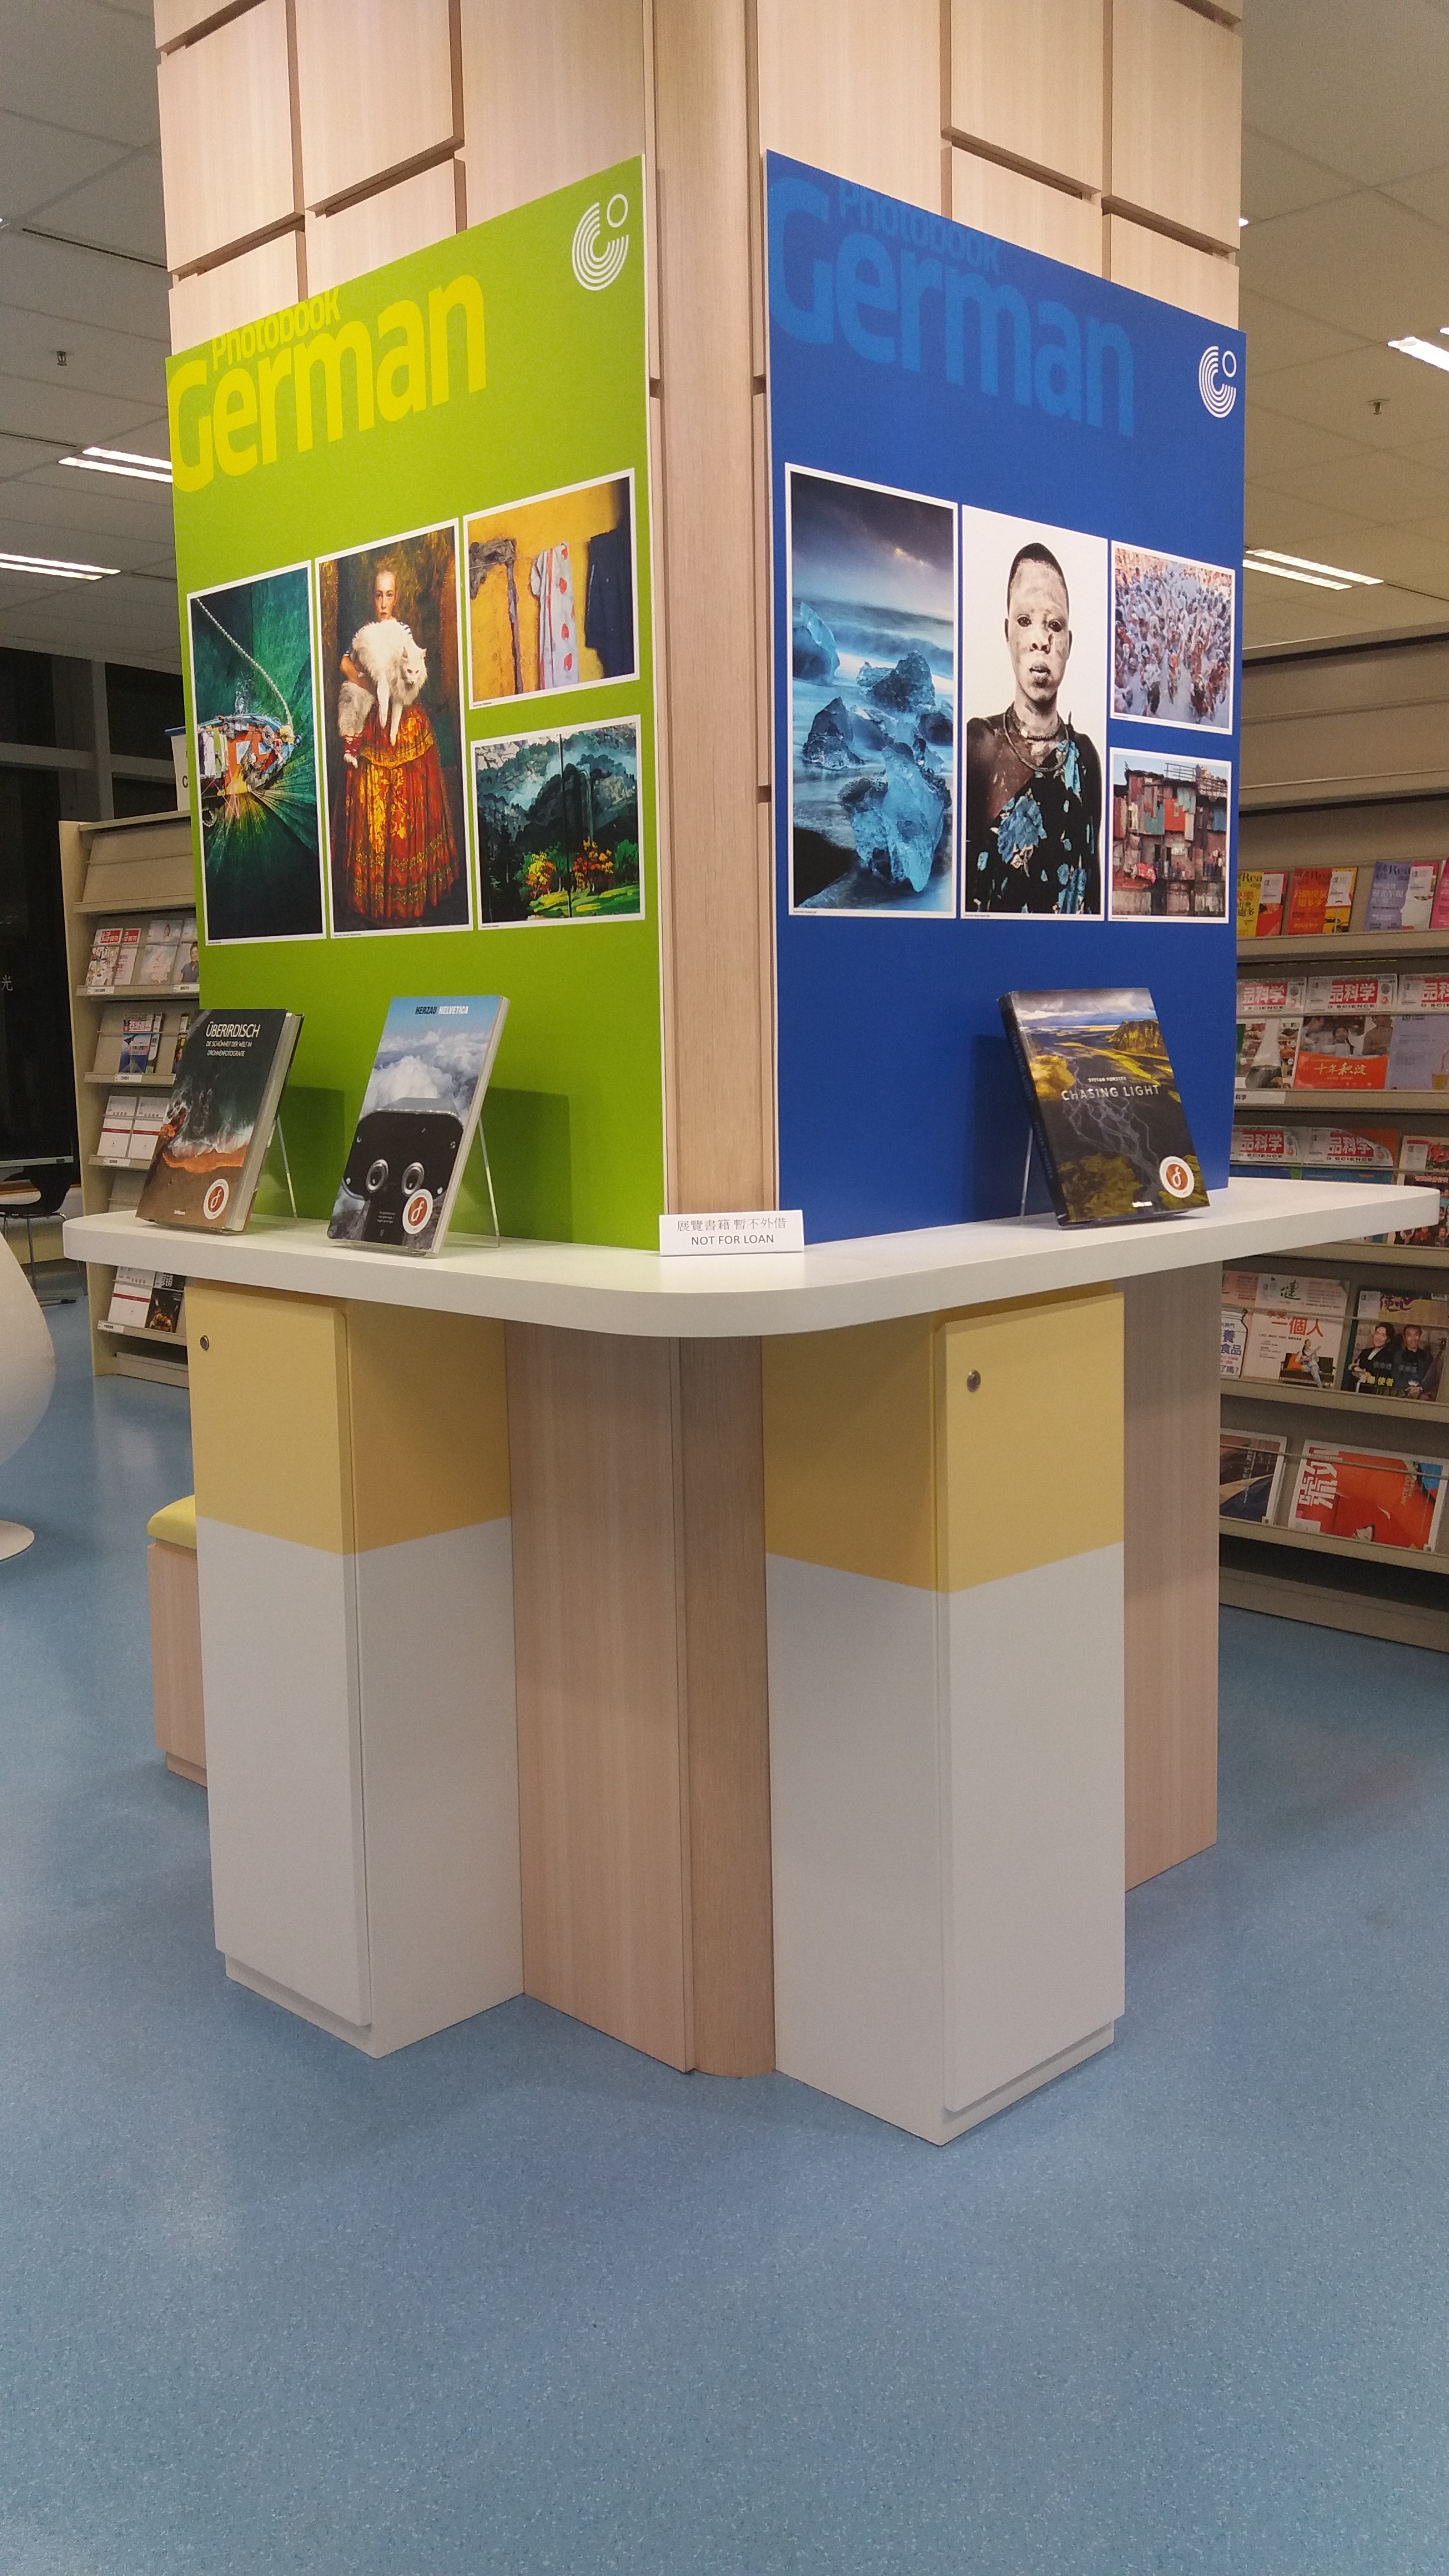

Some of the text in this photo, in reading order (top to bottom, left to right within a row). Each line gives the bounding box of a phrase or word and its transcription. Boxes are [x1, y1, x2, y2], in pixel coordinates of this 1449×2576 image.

[839, 183, 999, 269] Photobook
[767, 177, 1134, 437] German
[211, 287, 341, 371] Photobook
[167, 275, 487, 493] German
[1, 975, 13, 991] 光
[415, 1005, 469, 1015] HERZAU HELVETICA
[205, 1021, 261, 1038] ÜBERIRDISCH
[1061, 1085, 1160, 1101] CHASING LIGHT
[677, 1217, 787, 1232] 展覽書籍 暫不外借
[691, 1234, 774, 1246] NOT FOR LOAN
[1271, 1317, 1324, 1337] 一個人
